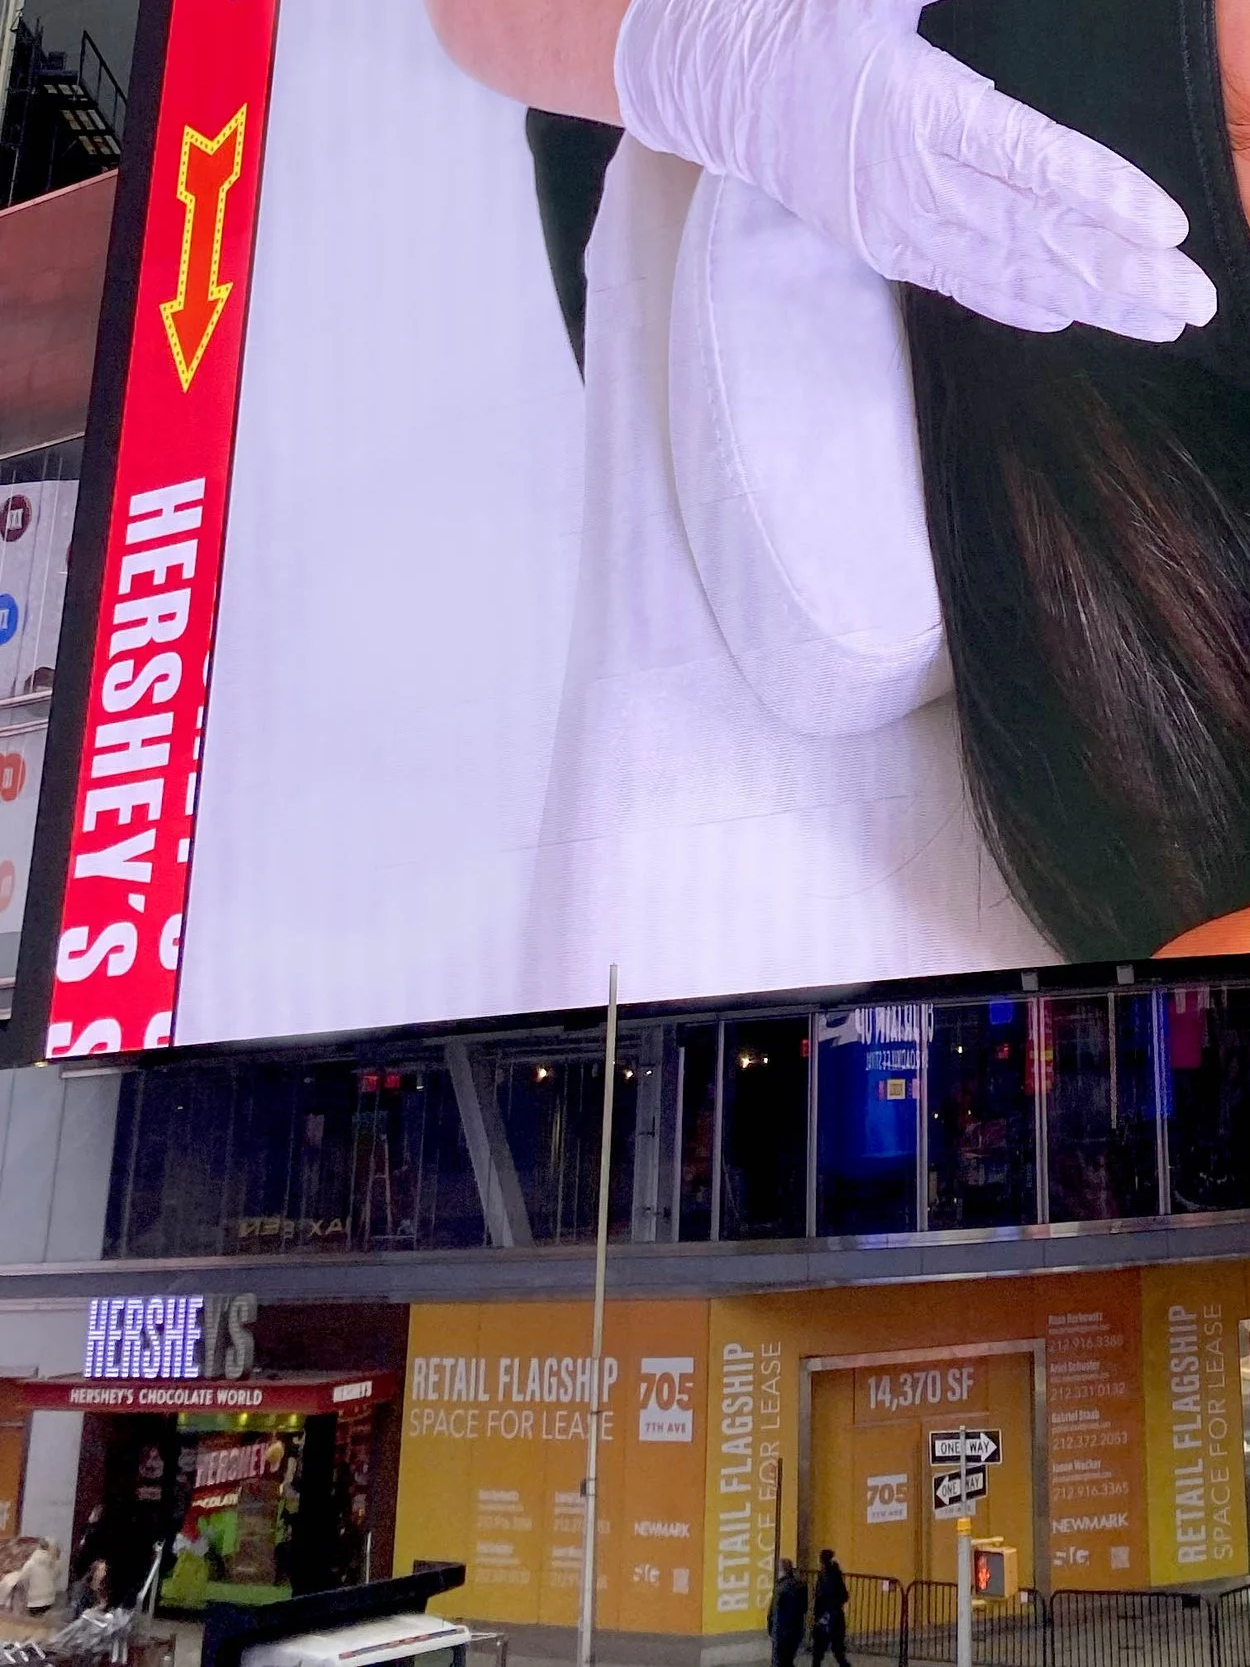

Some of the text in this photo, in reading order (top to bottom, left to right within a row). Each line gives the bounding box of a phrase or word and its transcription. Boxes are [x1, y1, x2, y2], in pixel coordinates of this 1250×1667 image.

[55, 477, 207, 984] HERSHEY'S
[70, 1389, 263, 1406] HERSHEY'S CHOCOLATE WORLD
[412, 1356, 619, 1404] RETAIL FLAGSHP
[638, 1371, 694, 1413] 705
[760, 1340, 781, 1430] LEASE
[867, 1367, 974, 1412] 14,370 SF
[409, 1408, 614, 1441] SPACE FOR LEAE
[644, 1421, 687, 1433] 7TH AVE
[1168, 1304, 1207, 1564] RETAIL FLAGSHIP
[1203, 1302, 1233, 1559] SPACE FOR LEASE
[940, 1441, 990, 1455] ONE WAY
[717, 1342, 754, 1612] RETAIL FLAGSHIP
[941, 1481, 957, 1497] ONE
[1052, 1513, 1128, 1534] NEWMARK
